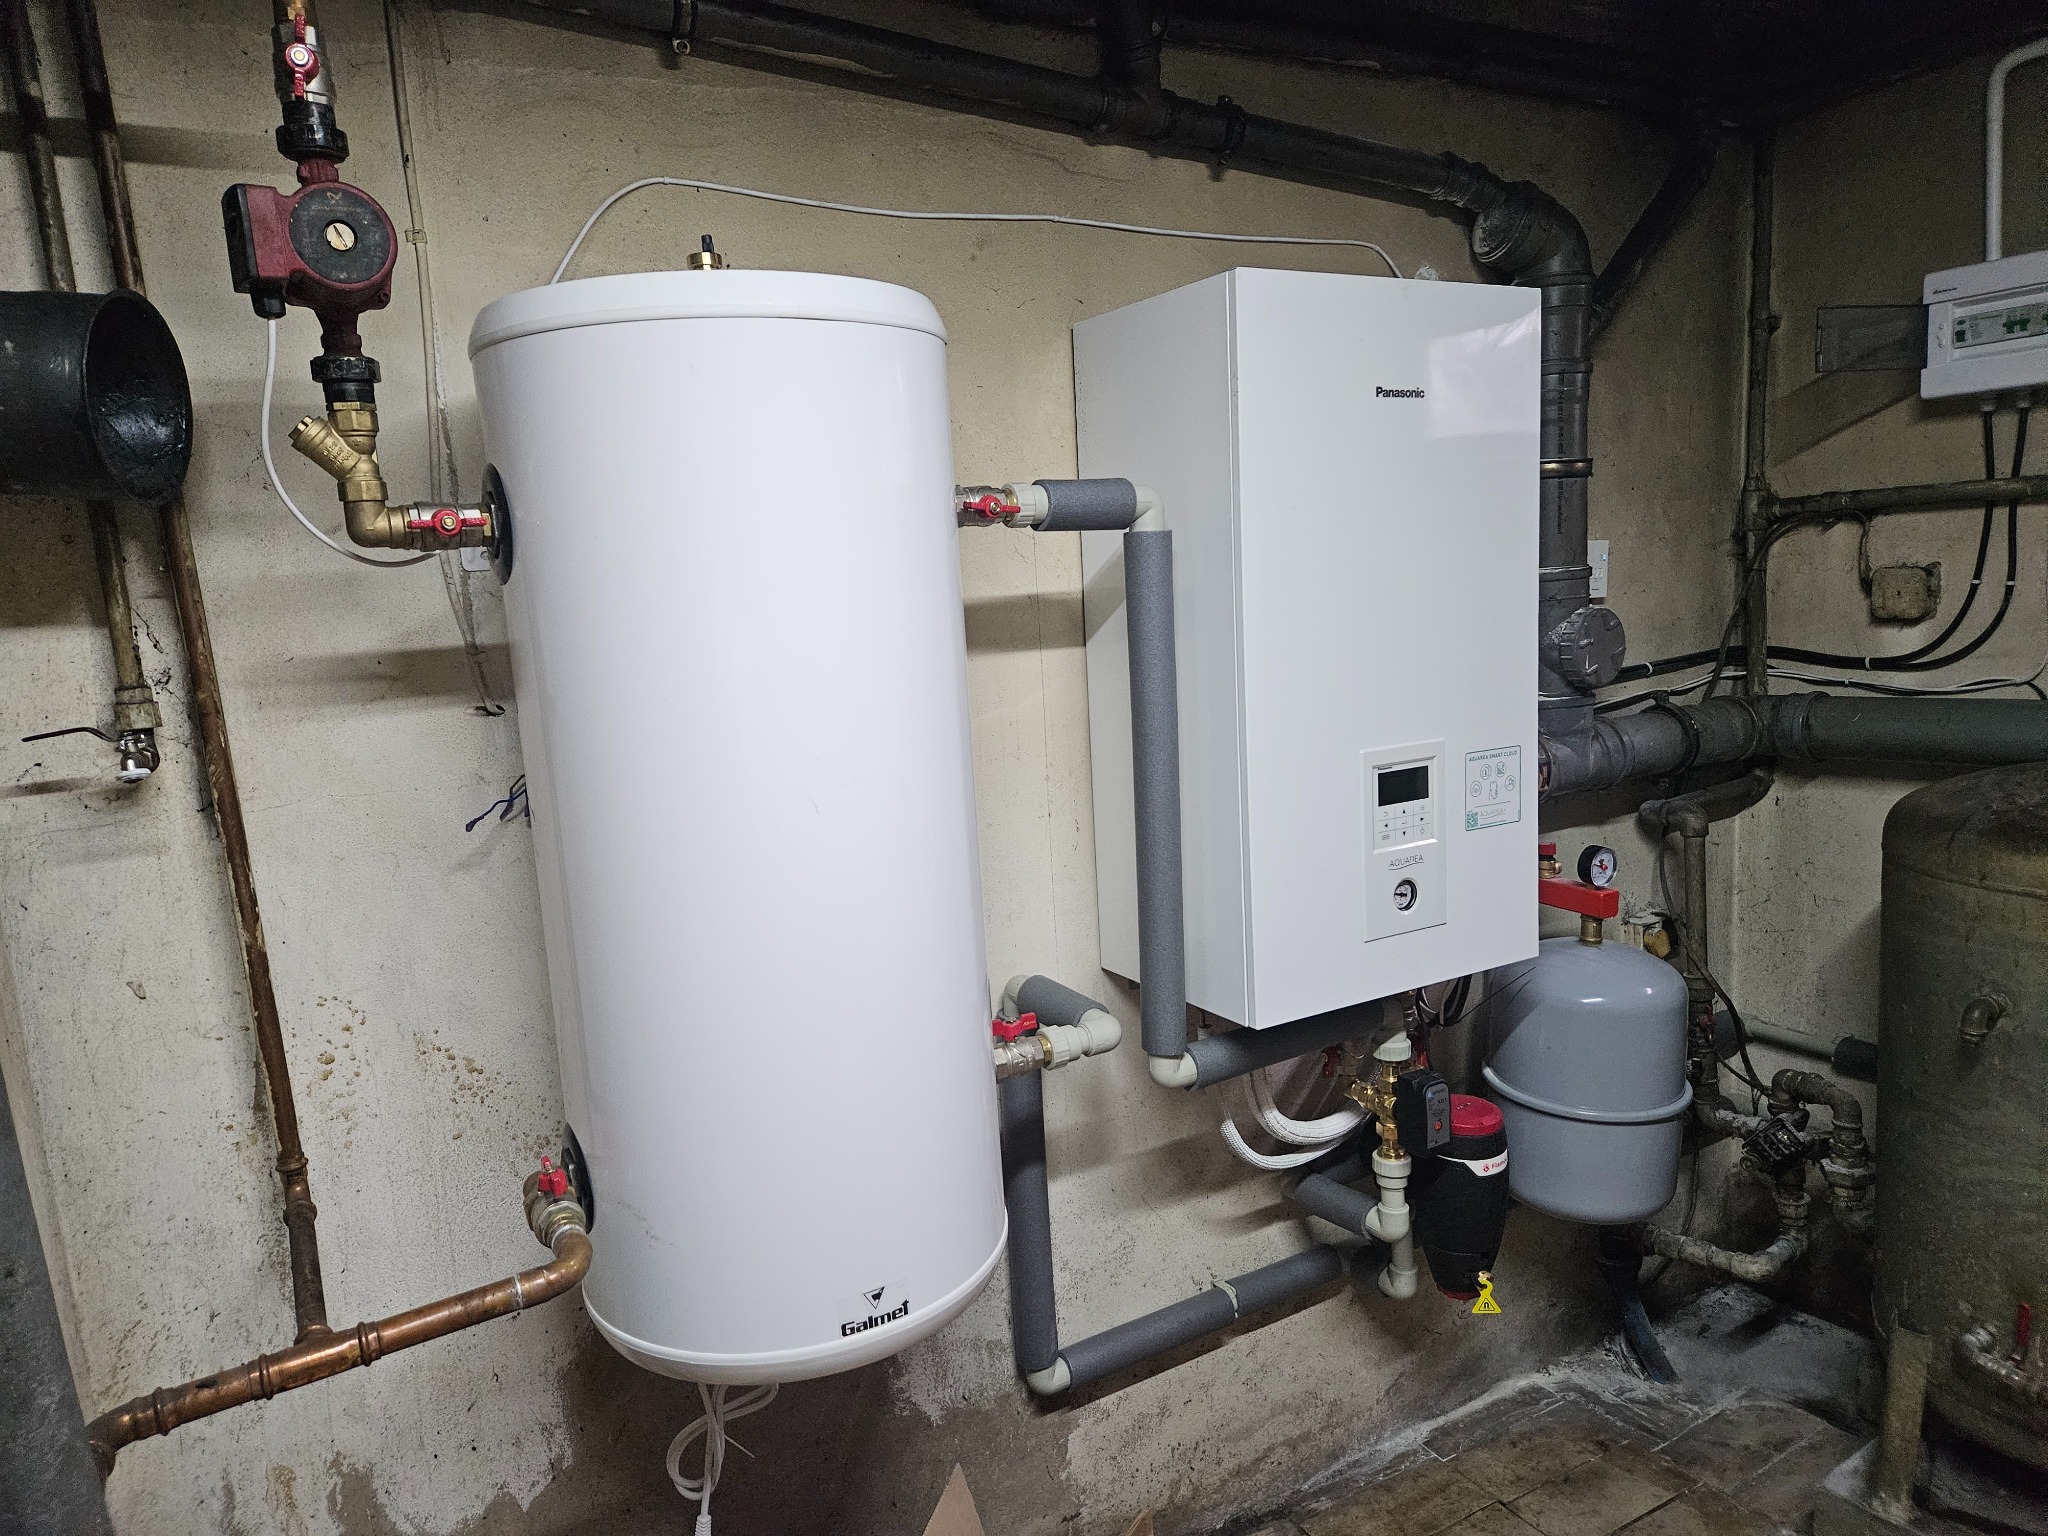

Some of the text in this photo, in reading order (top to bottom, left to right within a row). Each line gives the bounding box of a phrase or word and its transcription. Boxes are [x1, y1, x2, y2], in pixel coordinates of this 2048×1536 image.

[1375, 386, 1425, 398] Panasonic
[1389, 854, 1424, 867] AQUAREA
[840, 1298, 909, 1337] Galmet
